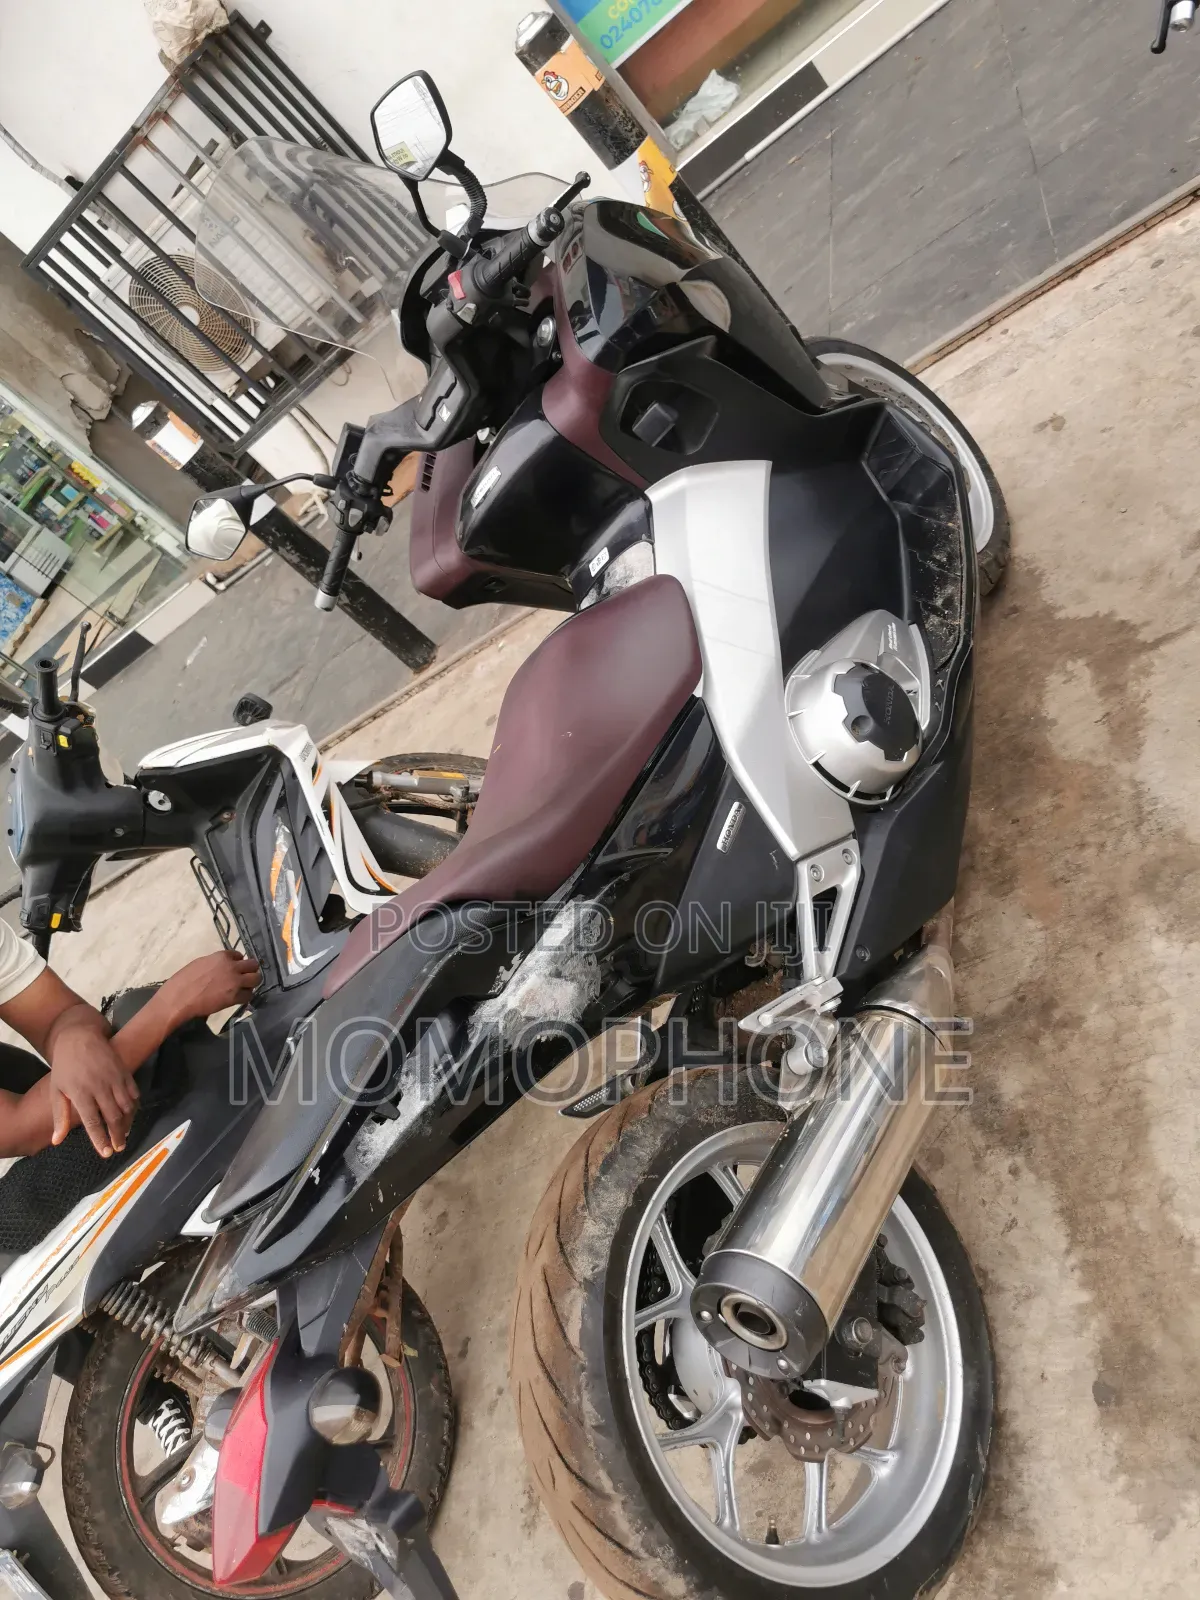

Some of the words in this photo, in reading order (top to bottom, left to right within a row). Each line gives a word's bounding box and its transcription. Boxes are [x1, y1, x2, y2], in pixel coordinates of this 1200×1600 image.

[608, 0, 633, 19] CO
[883, 684, 895, 726] HONDA
[721, 807, 742, 847] HONDA
